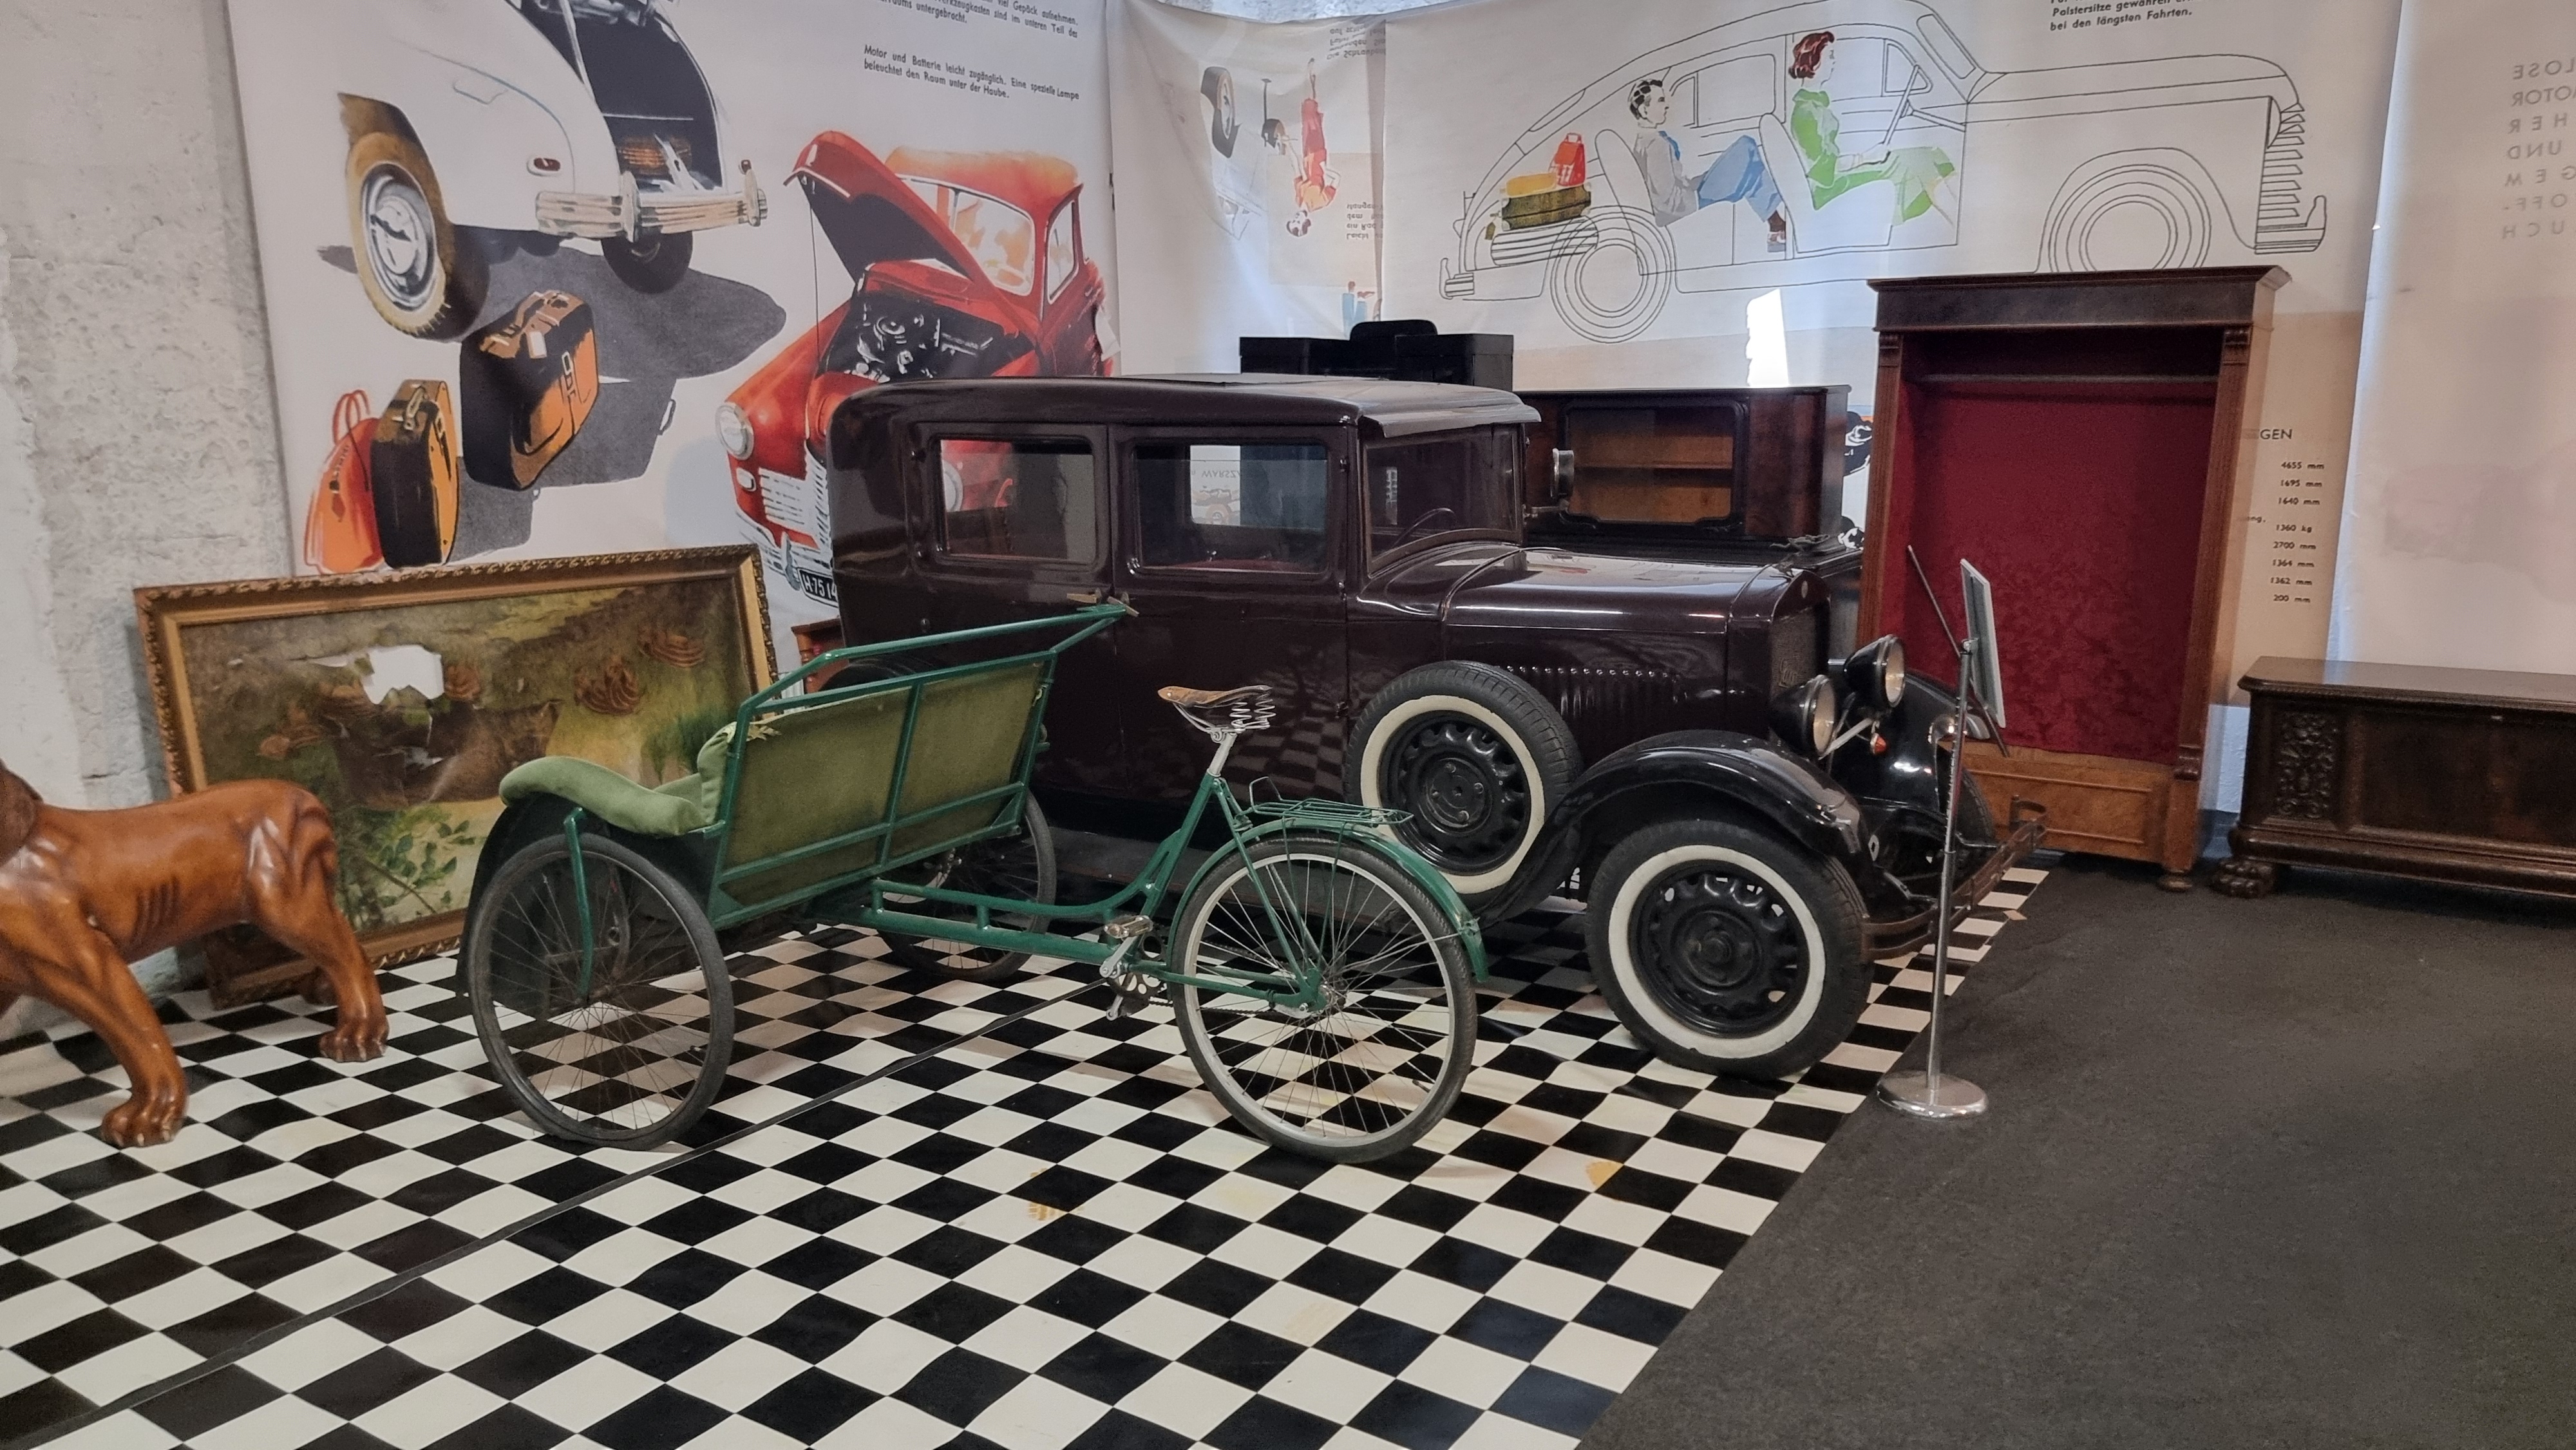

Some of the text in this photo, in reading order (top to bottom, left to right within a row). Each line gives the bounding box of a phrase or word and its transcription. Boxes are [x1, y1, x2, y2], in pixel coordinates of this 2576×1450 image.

[916, 3, 967, 23] untergebracht.
[935, 0, 1077, 38] erkzeugkasten sind im unteren Teil des
[1013, 1, 1038, 15] Gepäck
[1042, 10, 1078, 26] aufnehmen.
[2050, 9, 2192, 31] bei den längsten Fahrten.
[2052, 4, 2112, 17] Polstersitze
[864, 44, 1079, 101] Motor und Batterie leicht zugänglich. Eine spezielle Lampe
[864, 58, 1010, 99] beleuchtet den Raum unter der Haube.
[2273, 541, 2295, 549] 2700
